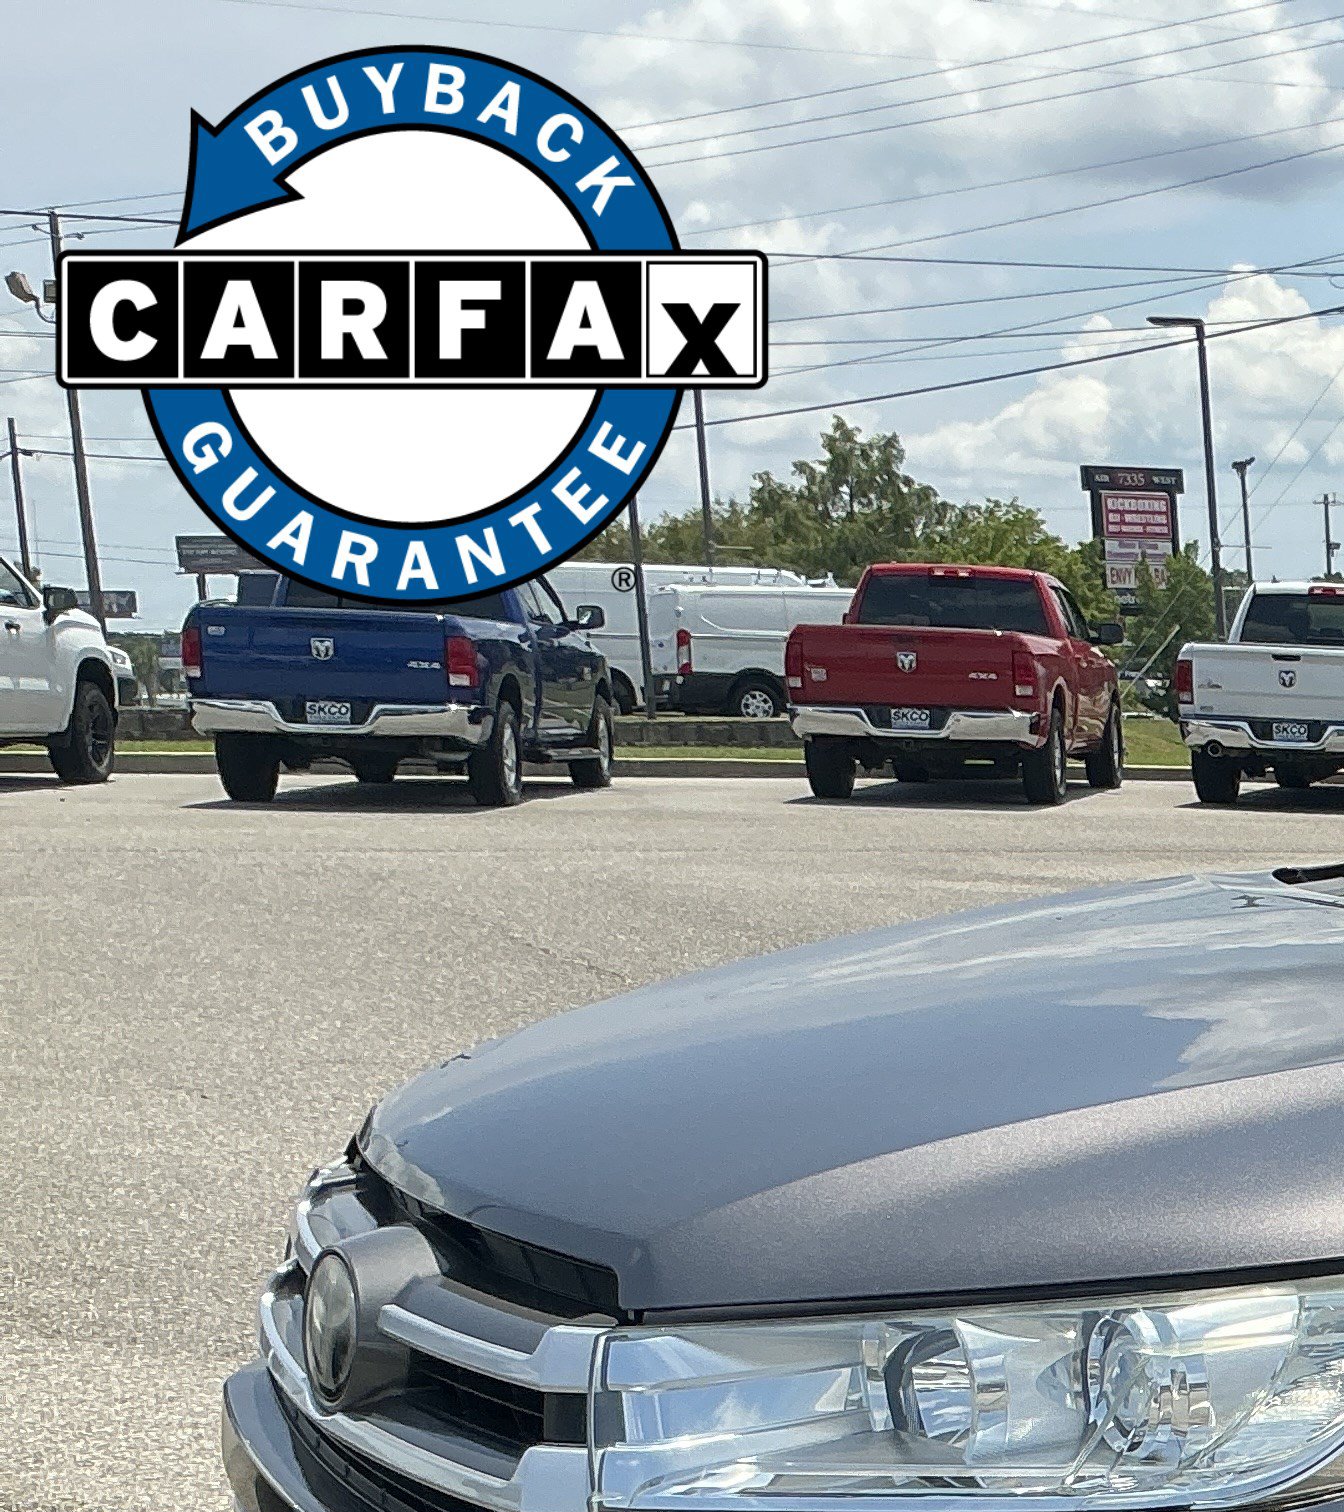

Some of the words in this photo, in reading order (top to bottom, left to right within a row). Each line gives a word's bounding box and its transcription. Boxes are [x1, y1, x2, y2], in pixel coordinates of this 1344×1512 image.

[1117, 472, 1145, 486] 7335
[306, 703, 350, 716] SKCO
[891, 710, 929, 722] SKCO
[1273, 723, 1307, 736] SKCO
